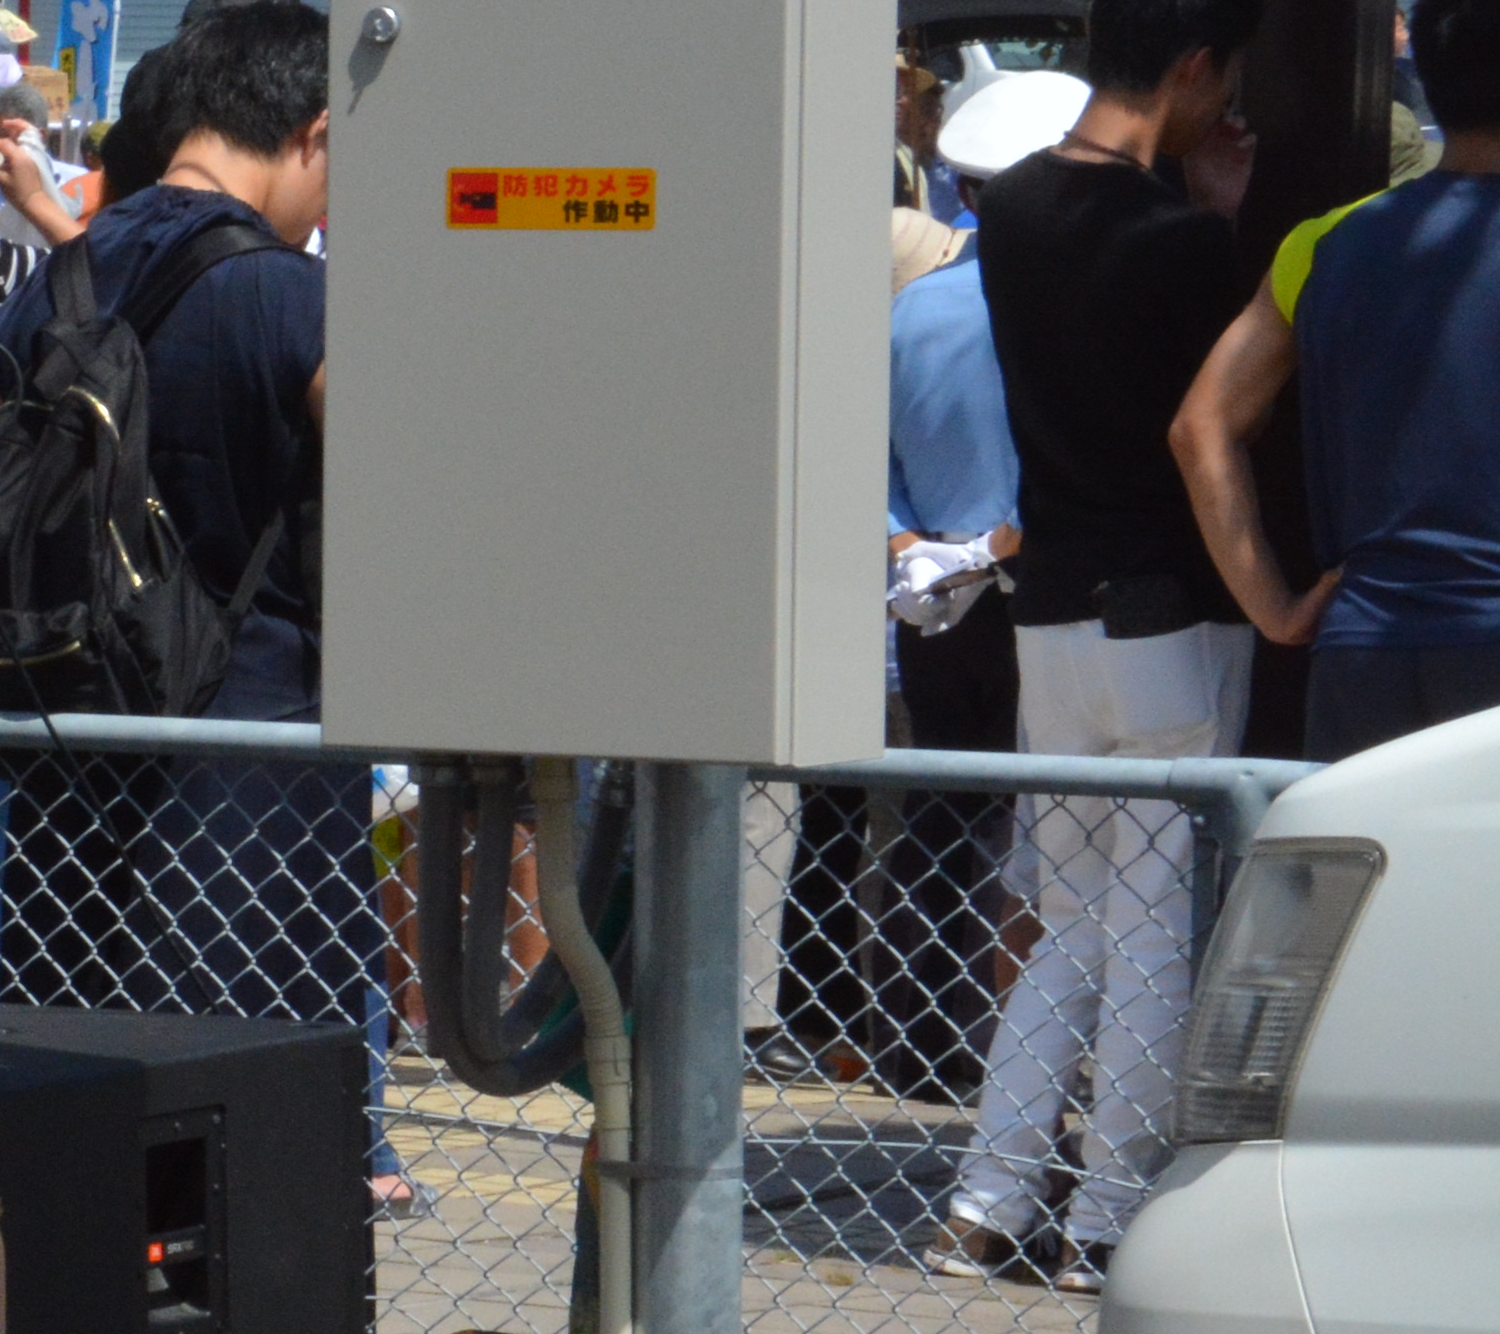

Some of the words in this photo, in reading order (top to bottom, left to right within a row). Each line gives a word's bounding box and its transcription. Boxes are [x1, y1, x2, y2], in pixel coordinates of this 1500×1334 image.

[503, 173, 650, 198] 防犯カメラ
[563, 199, 650, 223] 作動中
